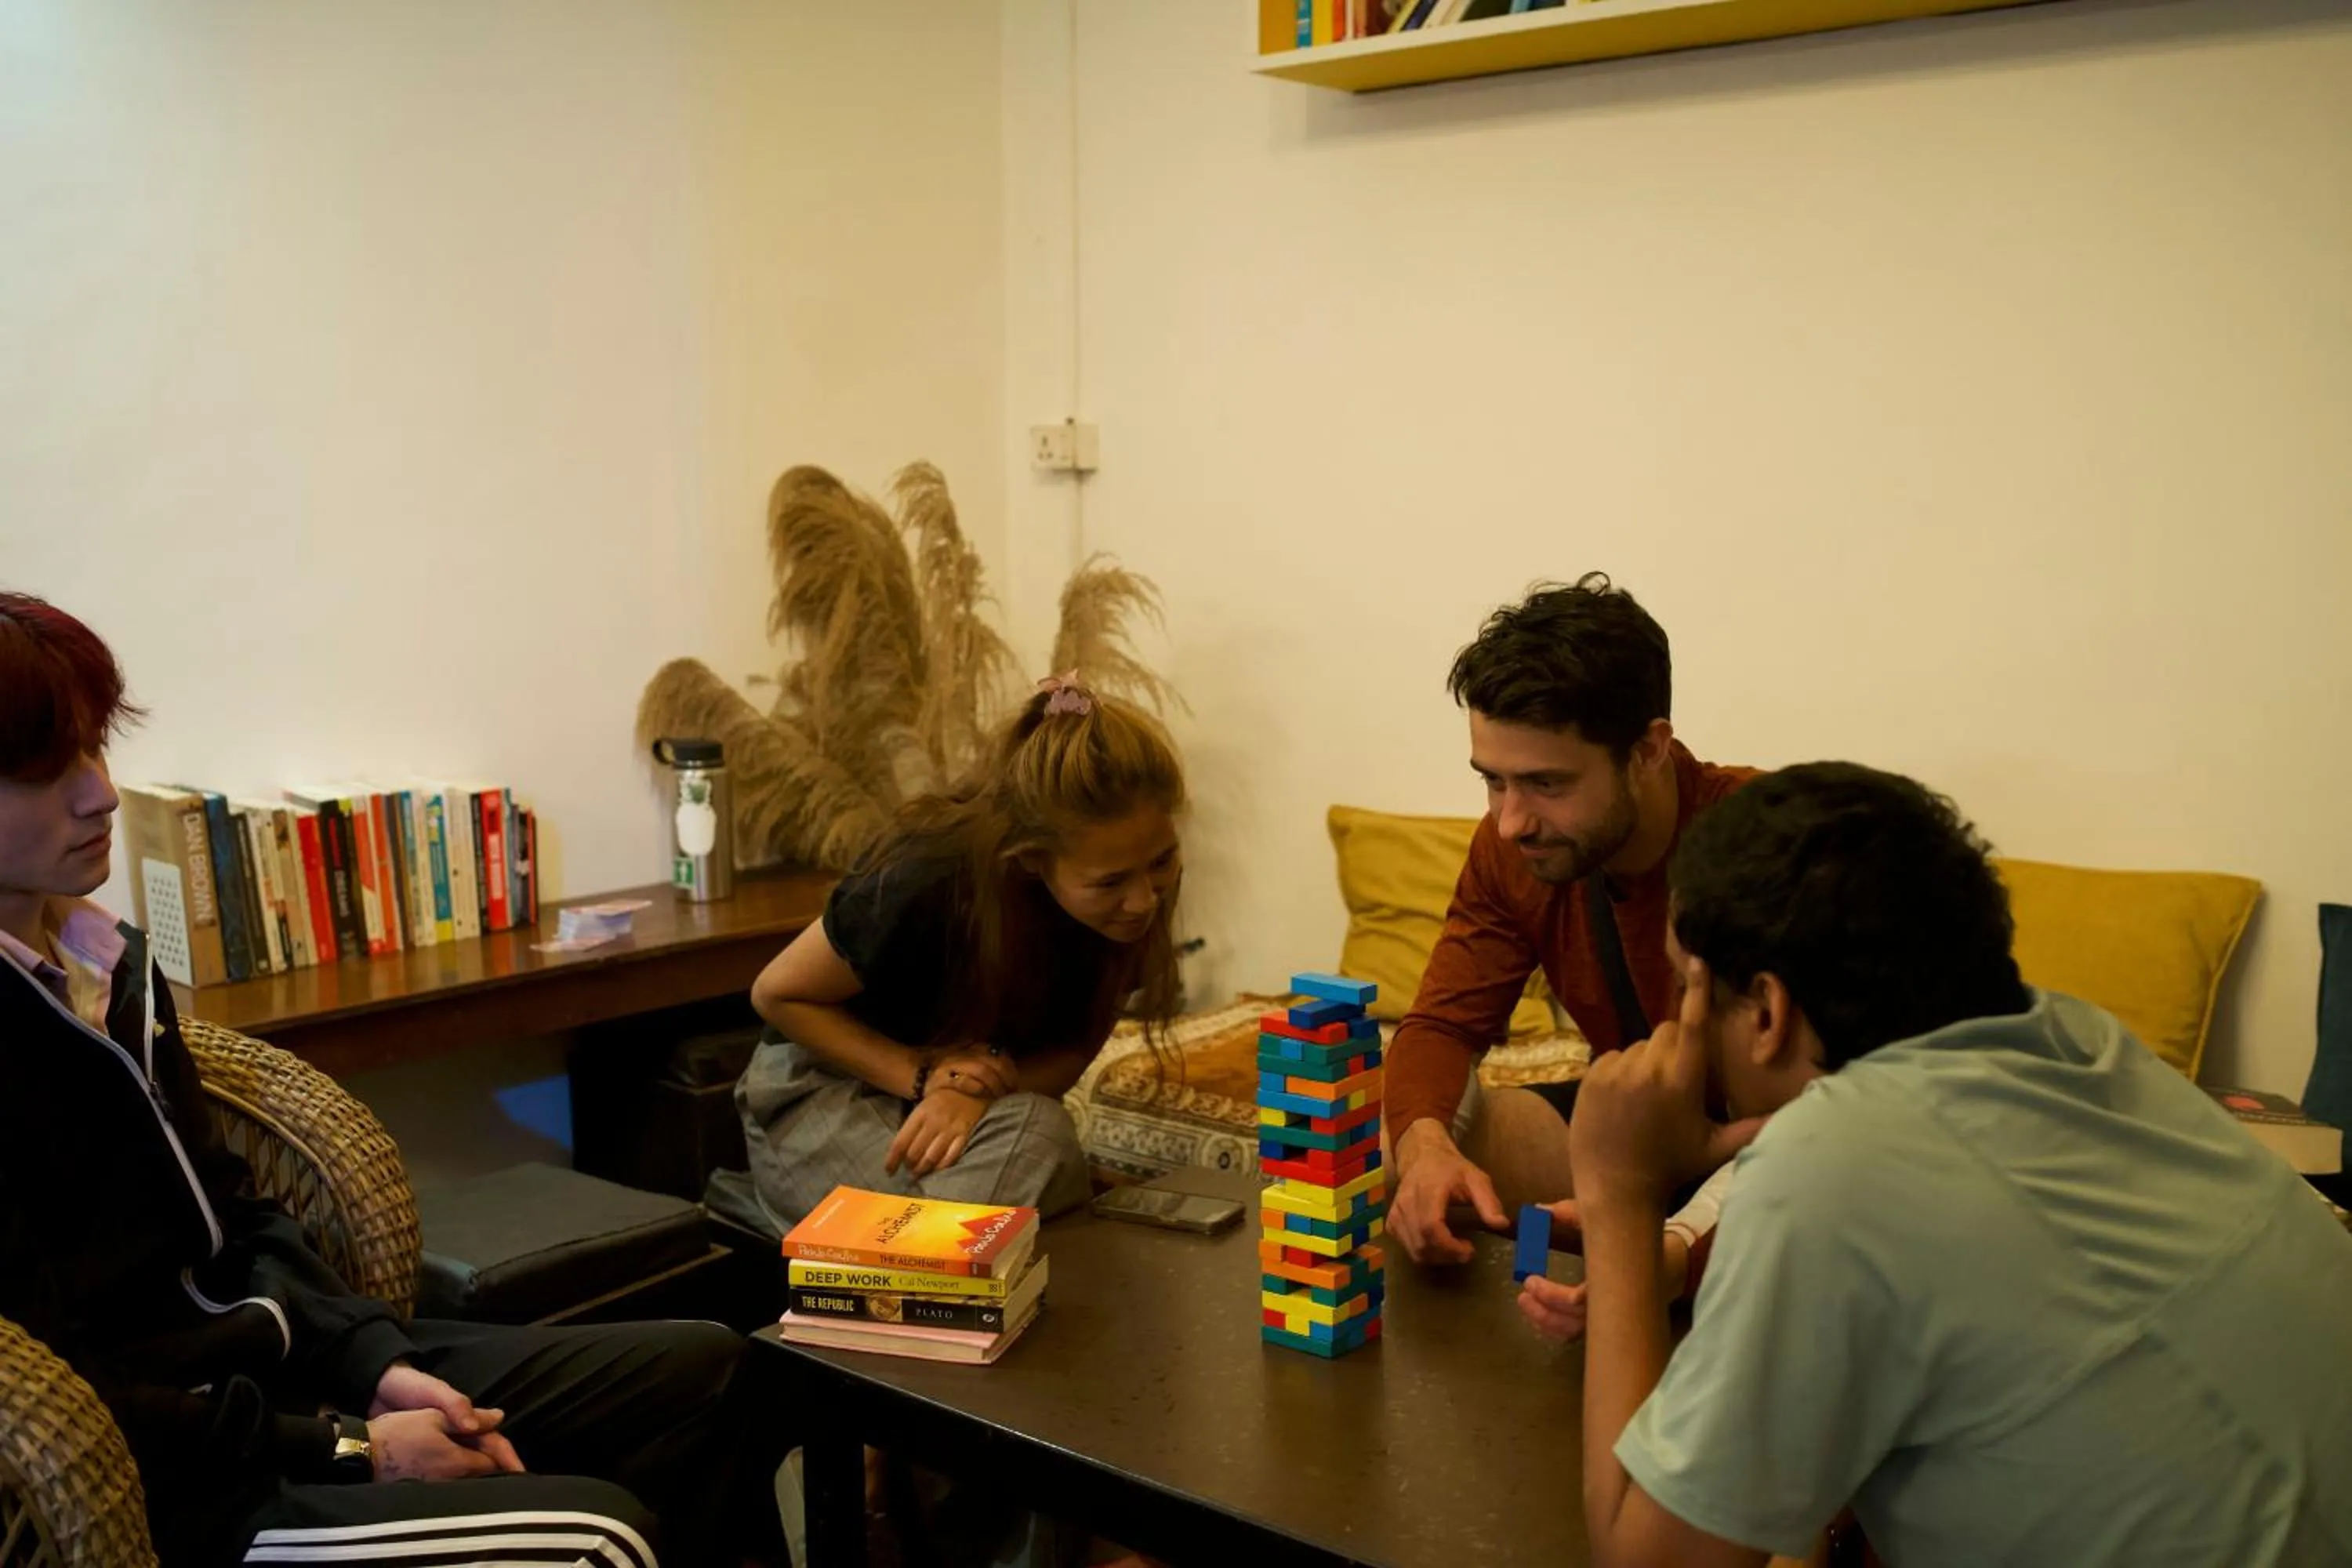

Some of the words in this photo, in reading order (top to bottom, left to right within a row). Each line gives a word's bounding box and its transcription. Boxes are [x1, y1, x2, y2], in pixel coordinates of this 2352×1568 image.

[183, 812, 204, 852] DAN
[188, 854, 214, 920] BROWN
[880, 1254, 895, 1265] THE
[898, 1256, 946, 1270] ALCHEMIST
[805, 1271, 842, 1283] DEEP
[847, 1273, 891, 1287] WORK
[898, 1277, 915, 1287] Cal
[916, 1278, 960, 1290] Newport
[802, 1296, 816, 1308] THE
[818, 1297, 855, 1312] REPUBLIC
[916, 1307, 953, 1319] PLATO
